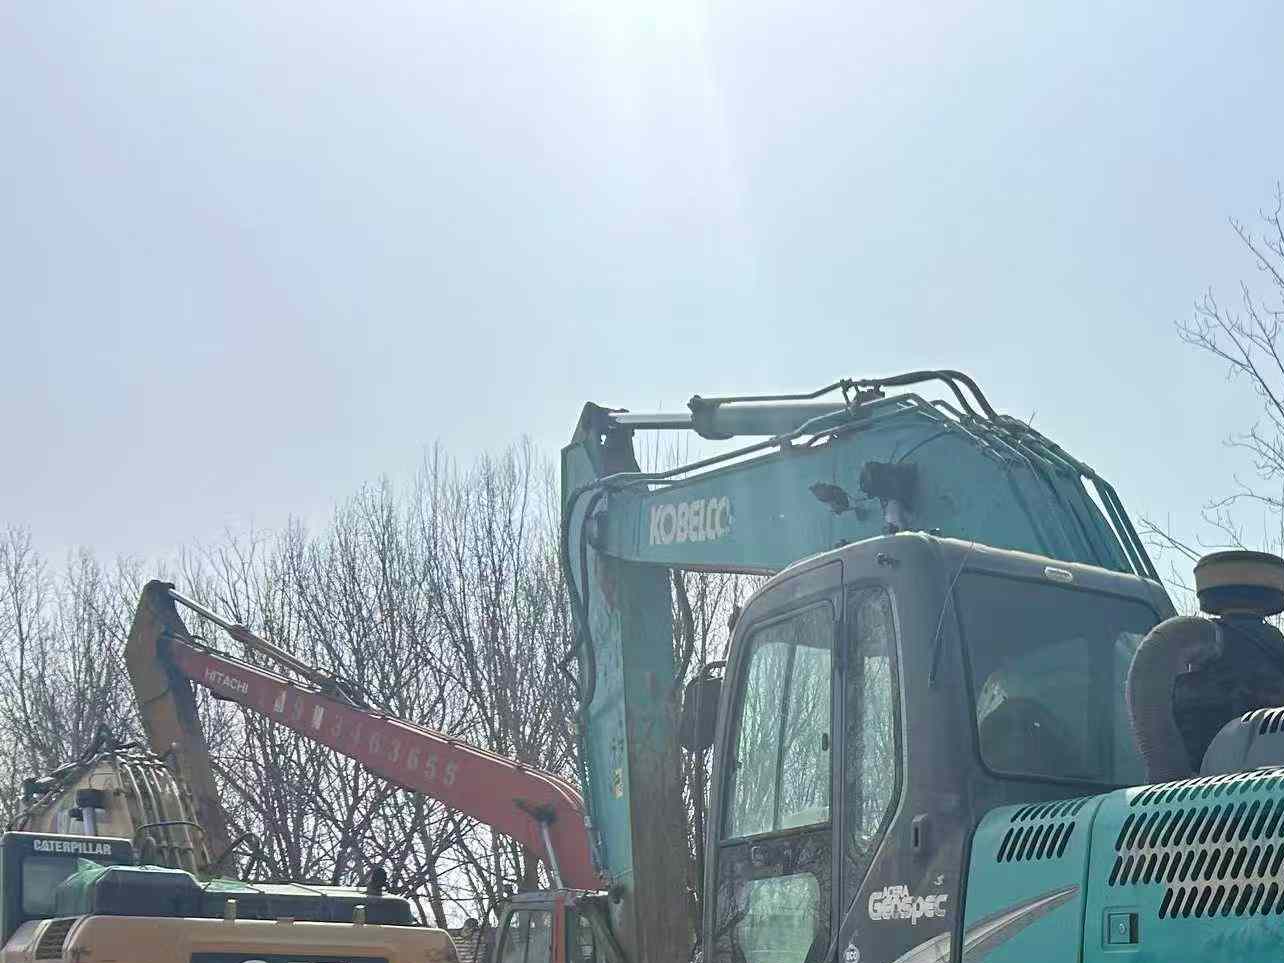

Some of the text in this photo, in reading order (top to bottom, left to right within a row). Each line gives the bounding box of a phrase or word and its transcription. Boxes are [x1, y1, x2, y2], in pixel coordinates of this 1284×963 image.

[649, 495, 732, 545] KOBELCO
[203, 669, 249, 693] HITACHI
[33, 839, 112, 855] CATERPILLAR
